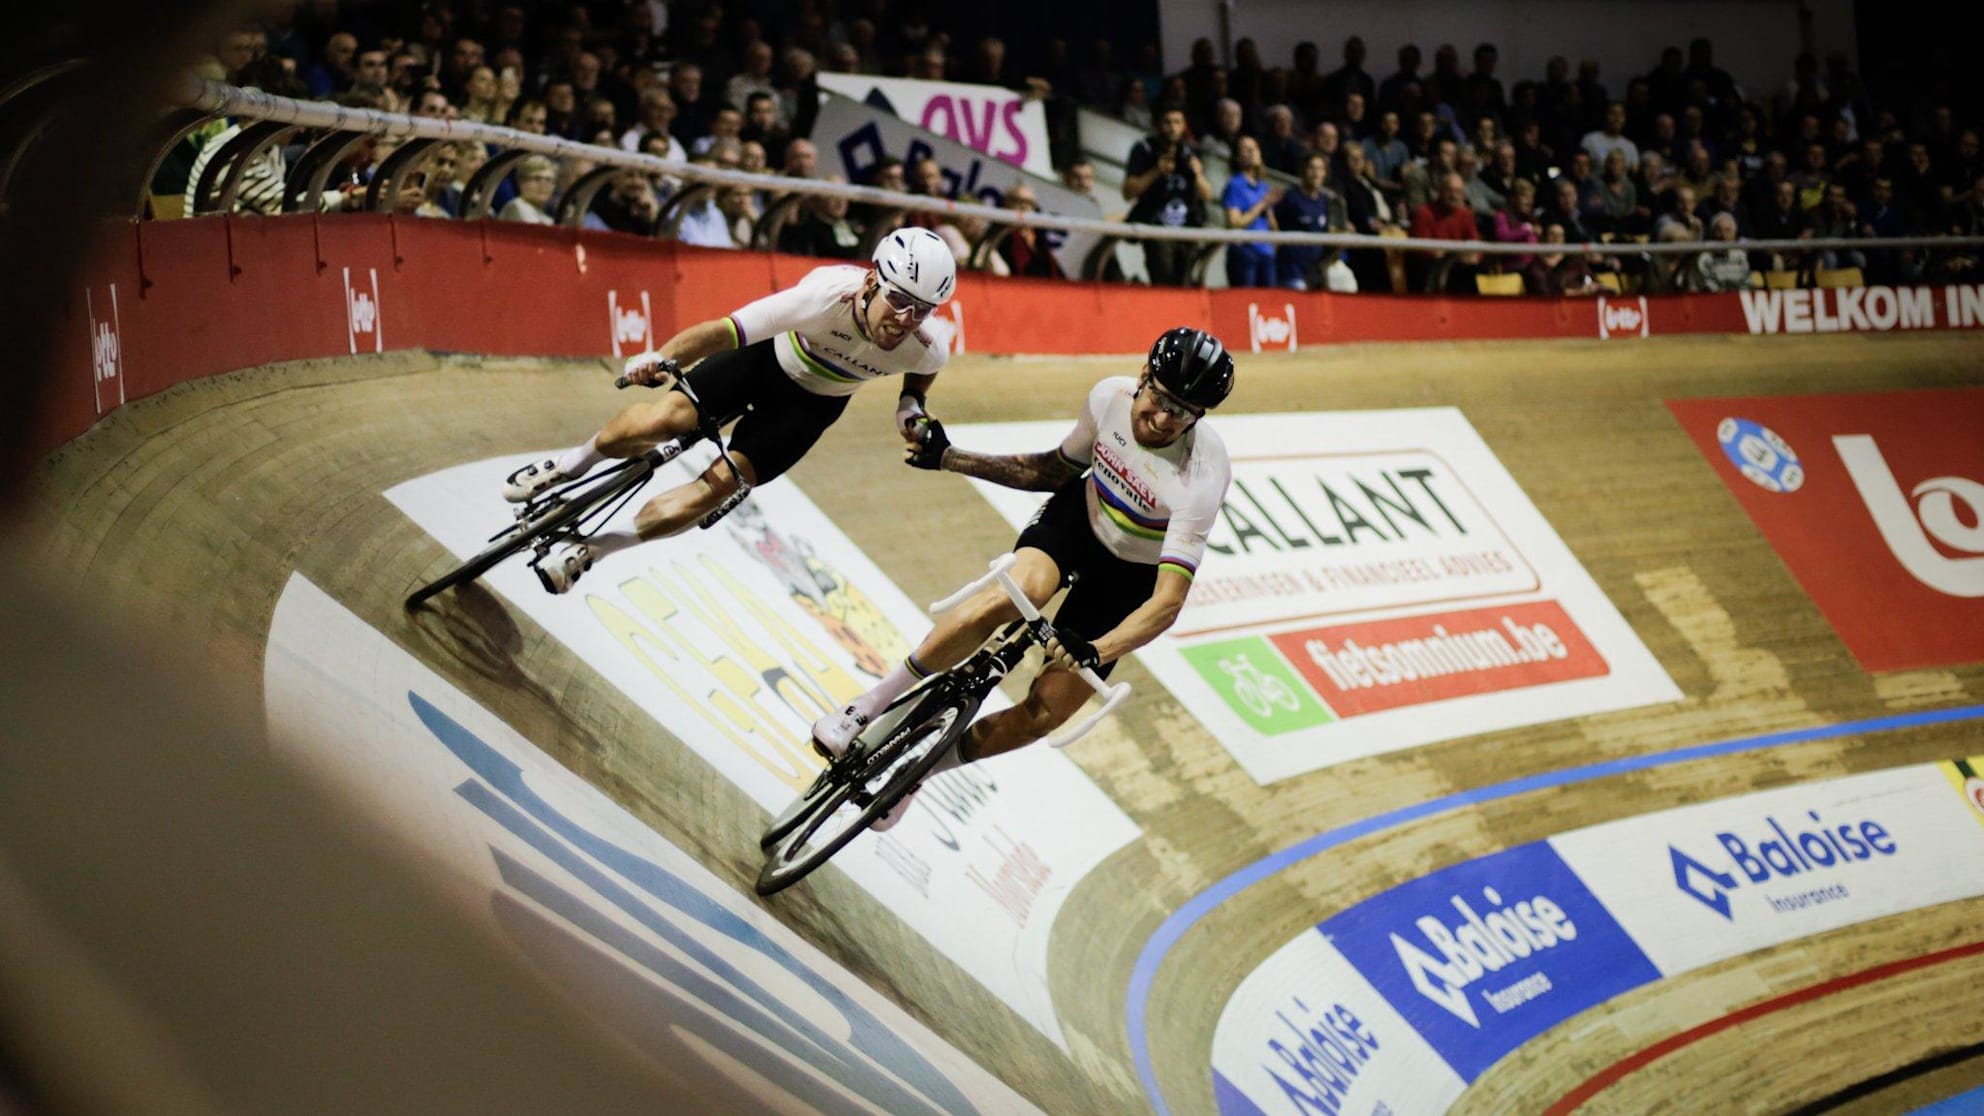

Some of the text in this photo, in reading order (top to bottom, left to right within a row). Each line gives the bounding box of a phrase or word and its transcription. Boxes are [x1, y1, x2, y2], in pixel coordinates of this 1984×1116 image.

[1739, 284, 1984, 335] WELKOM IN
[1304, 616, 1569, 691] fietsomnium.be
[1715, 809, 1897, 883] Baloise
[1416, 886, 1577, 982] Baloise
[1766, 883, 1849, 913] Insurance
[1267, 996, 1379, 1110] Baloise
